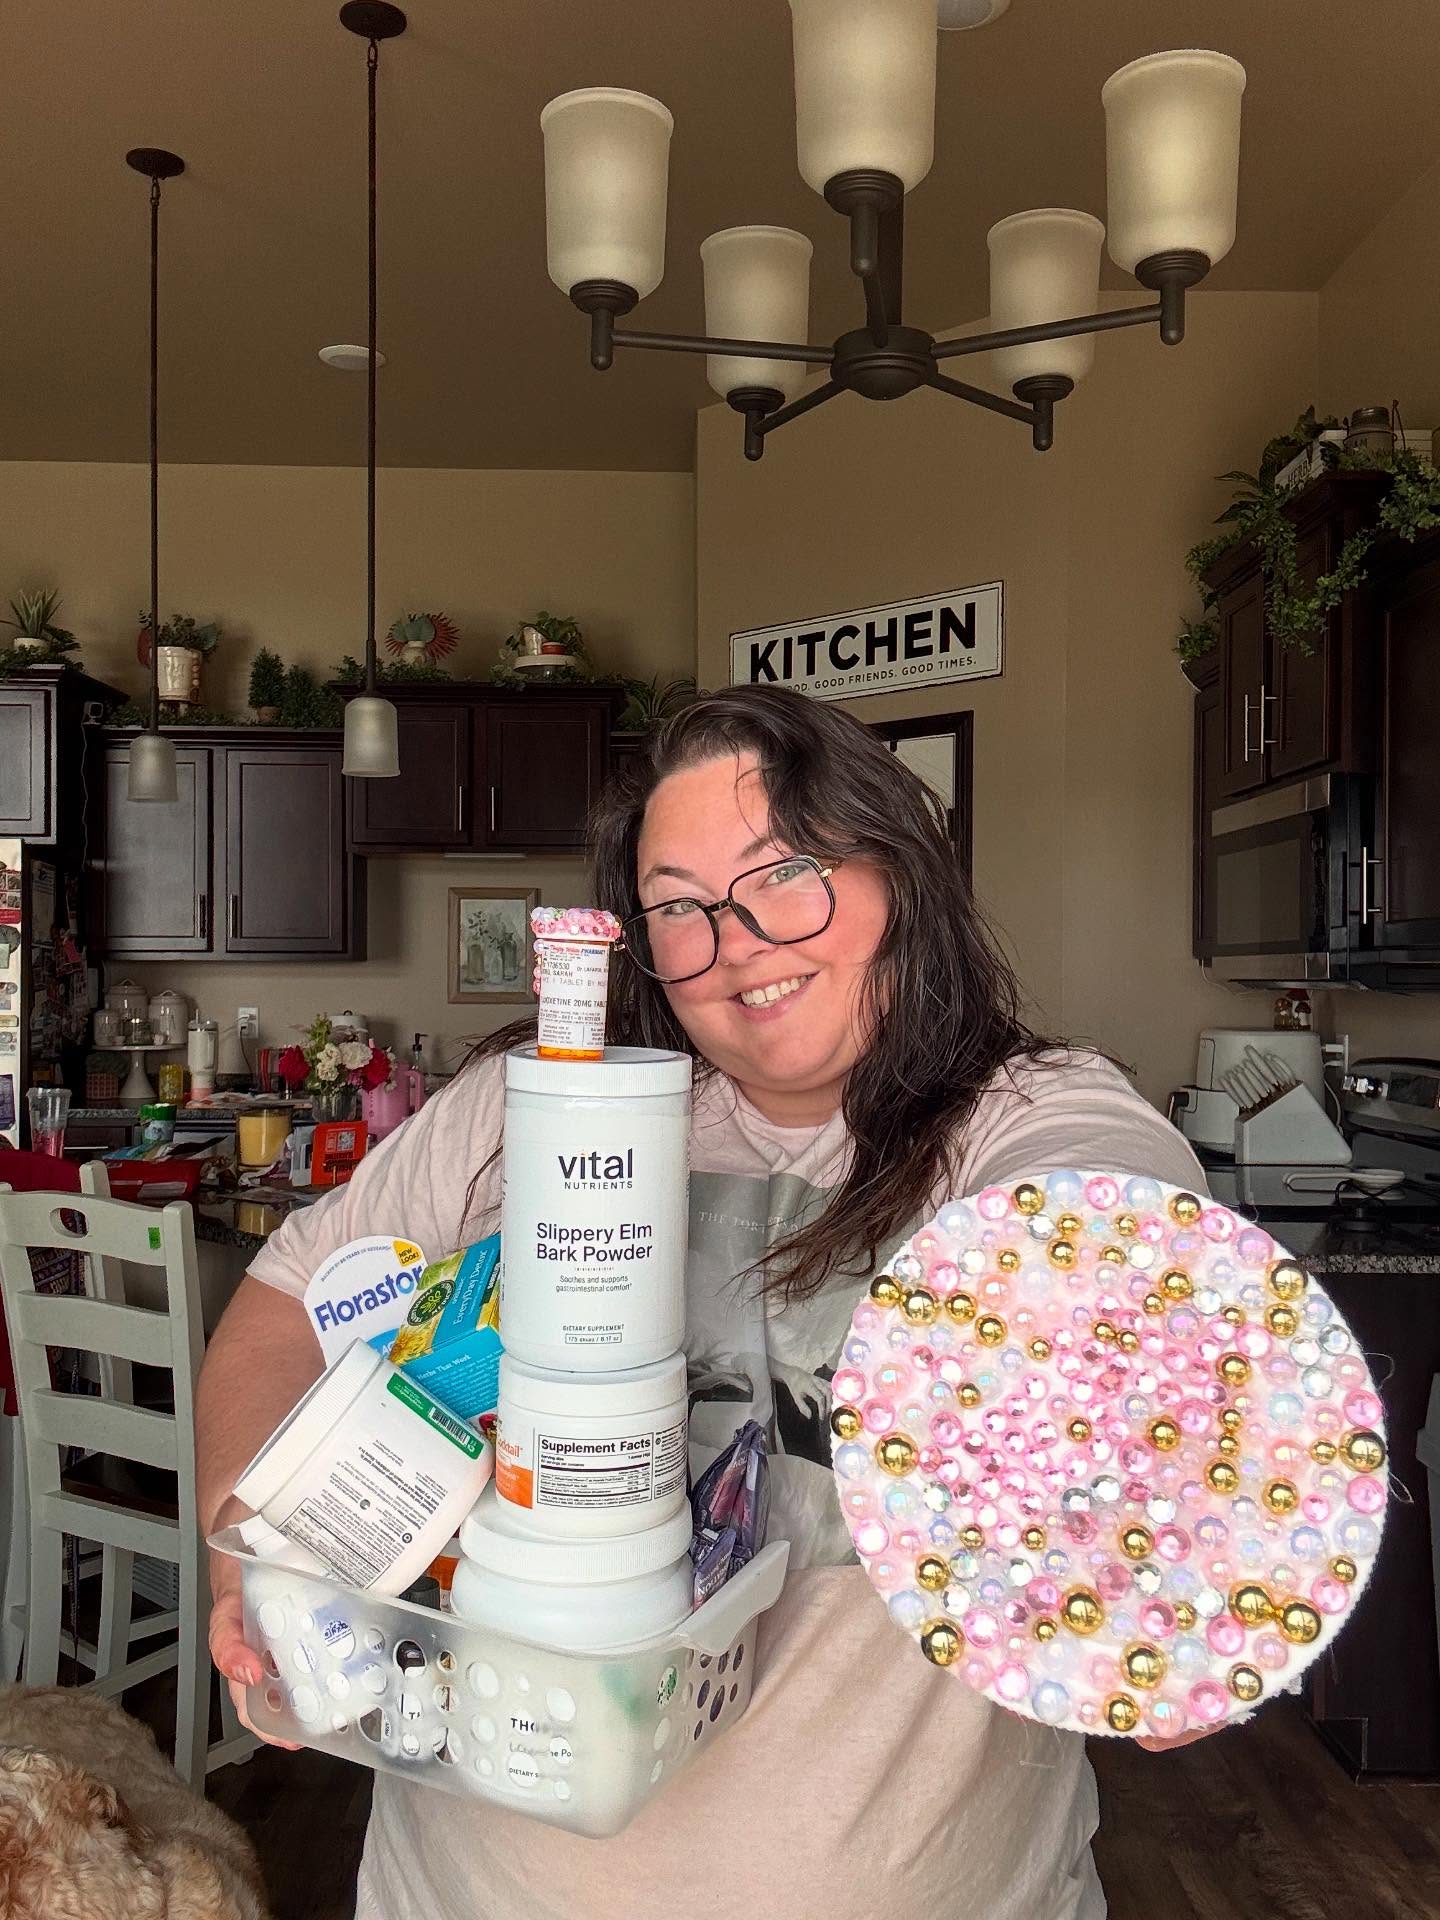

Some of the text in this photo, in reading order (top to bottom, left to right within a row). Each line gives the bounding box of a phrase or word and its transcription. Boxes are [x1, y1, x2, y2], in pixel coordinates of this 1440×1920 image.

[750, 601, 976, 683] KITCHEN
[815, 677, 845, 689] GOOD
[848, 670, 897, 685] FRIENDS.
[902, 662, 934, 676] GOOD
[938, 656, 977, 670] TIMES.
[558, 1148, 633, 1180] vital
[564, 1181, 633, 1190] NUTRIENTS
[536, 1222, 652, 1244] Slippery Elm
[346, 1250, 360, 1259] YEARS
[399, 1248, 413, 1258] NEW
[401, 1252, 419, 1265] LOOK!
[536, 1243, 653, 1262] Bark Powder
[560, 1275, 585, 1283] Soothes
[601, 1275, 628, 1284] supports
[556, 1285, 604, 1293] gastrointestinal
[314, 1265, 423, 1332] Florastor
[436, 1363, 452, 1373] That
[541, 1438, 651, 1454] Supplement Facts
[508, 1767, 533, 1777] DIETARY
